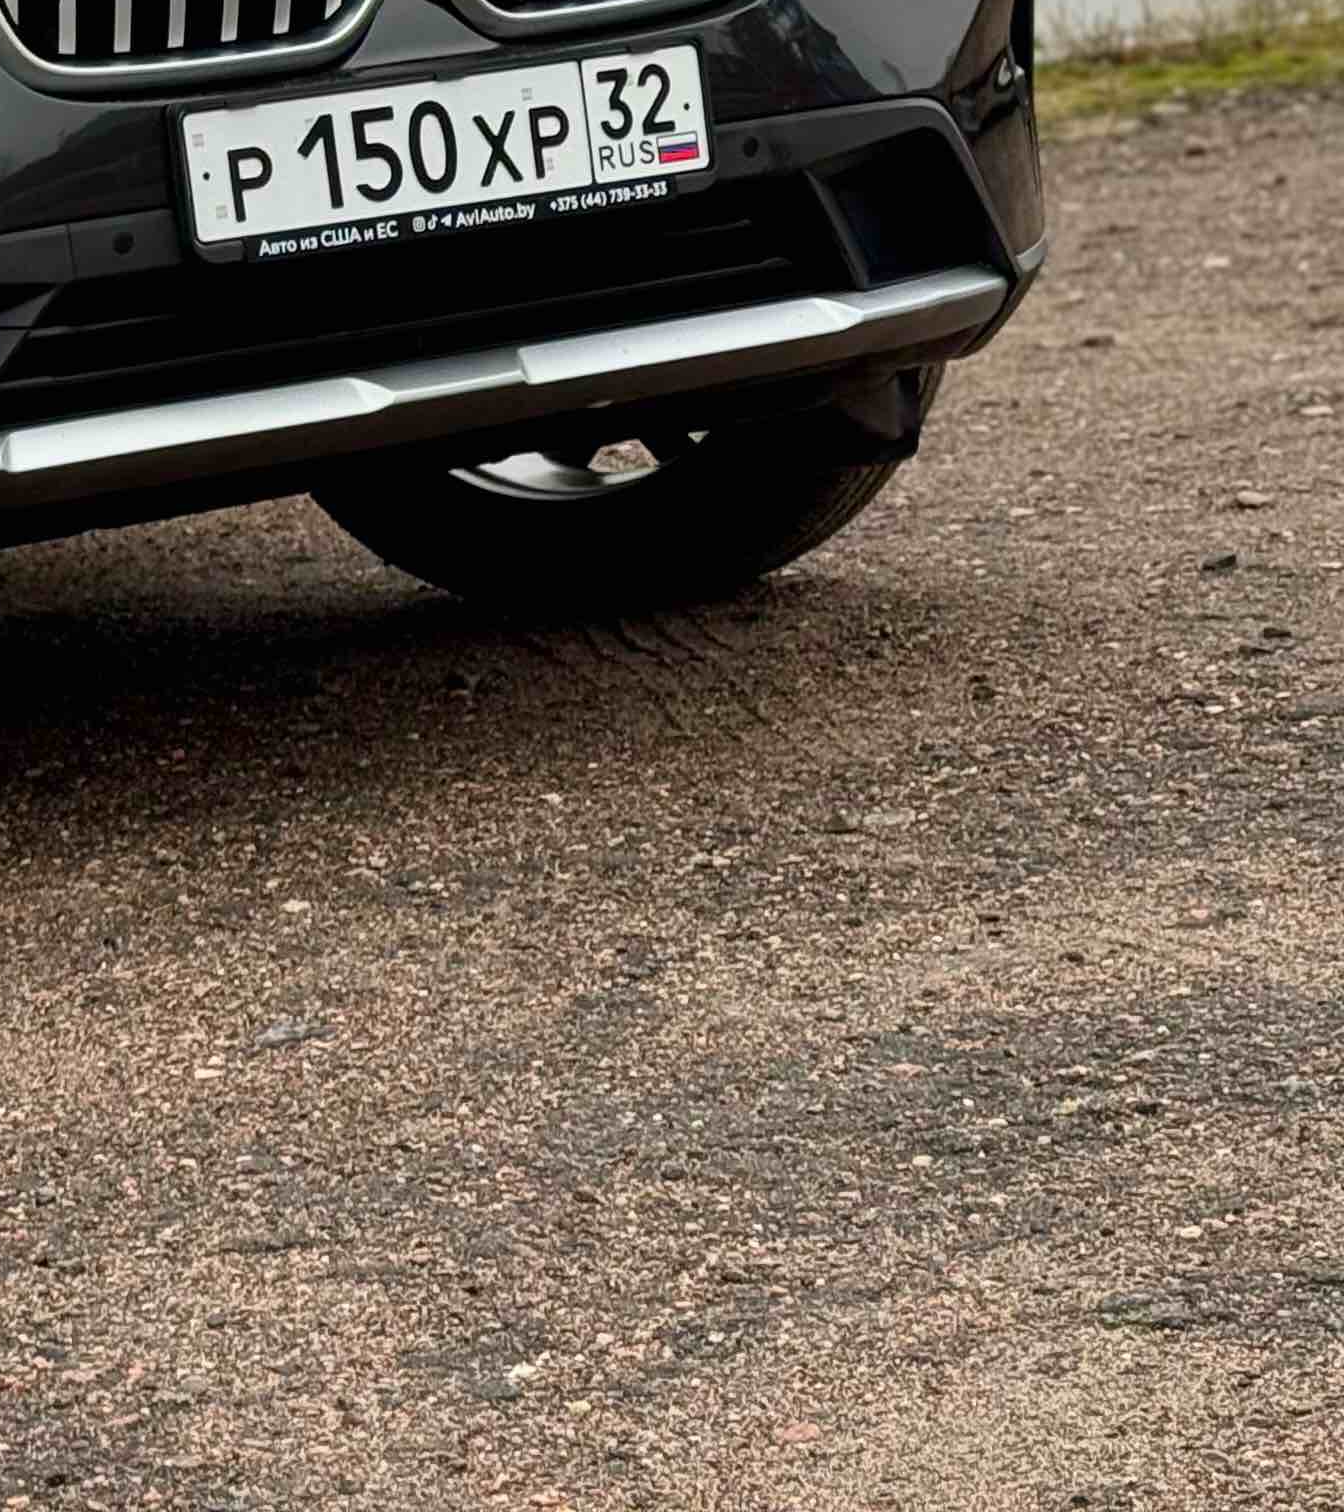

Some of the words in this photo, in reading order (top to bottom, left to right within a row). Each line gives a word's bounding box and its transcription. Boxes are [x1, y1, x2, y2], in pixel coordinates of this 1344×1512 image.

[596, 63, 676, 140] 32
[598, 140, 655, 171] RUS
[259, 240, 297, 257] Авто
[300, 237, 319, 251] из
[320, 227, 363, 249] США
[363, 229, 375, 241] и
[376, 221, 400, 240] ЕС
